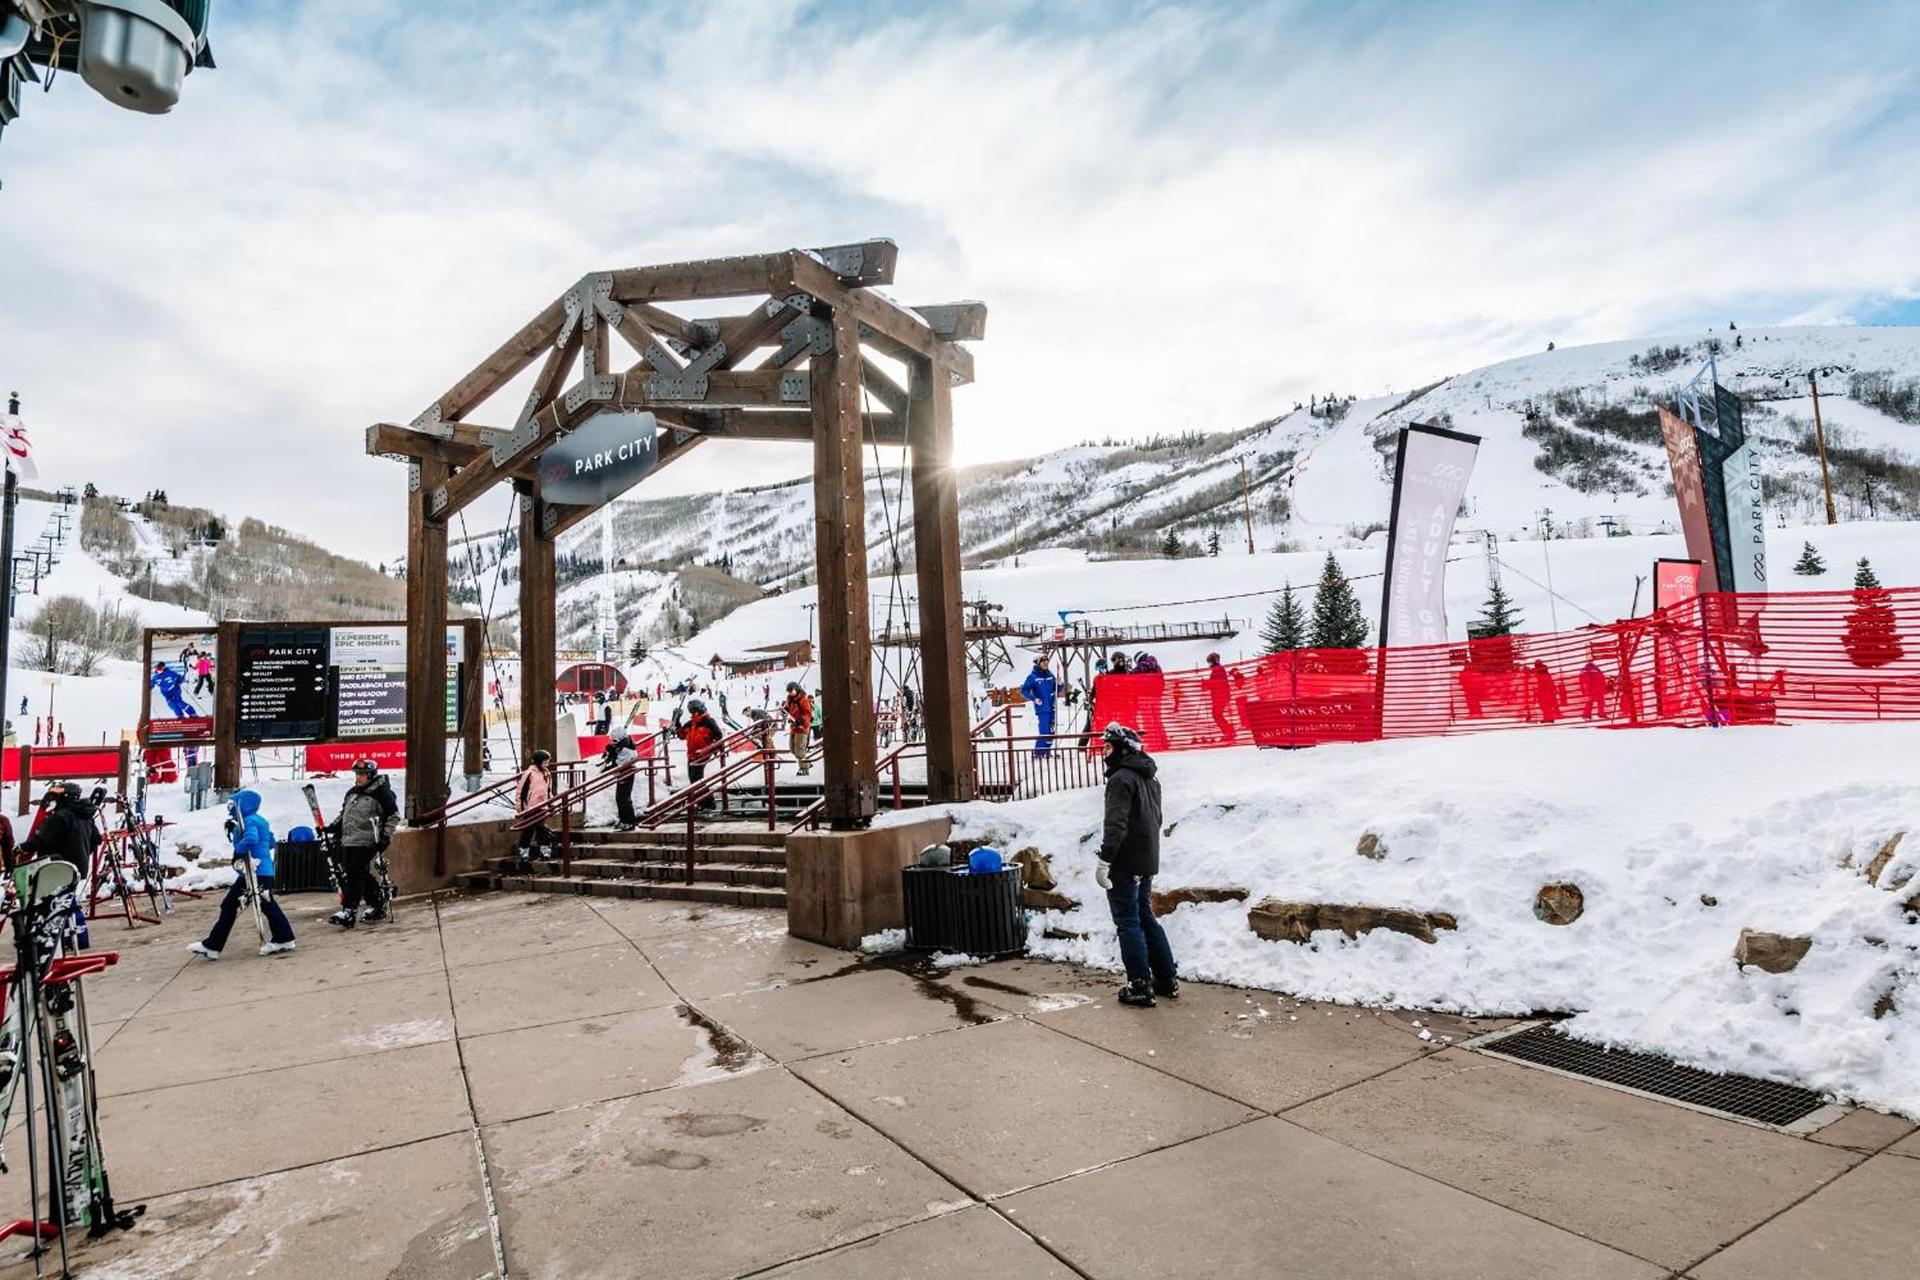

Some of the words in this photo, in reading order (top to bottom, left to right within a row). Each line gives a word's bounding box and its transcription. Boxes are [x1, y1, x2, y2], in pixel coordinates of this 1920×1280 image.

[575, 449, 613, 475] PARK
[618, 435, 652, 461] CITY
[1749, 449, 1760, 490] CITY
[1752, 499, 1763, 543] PARK
[1421, 504, 1446, 595] ADULT
